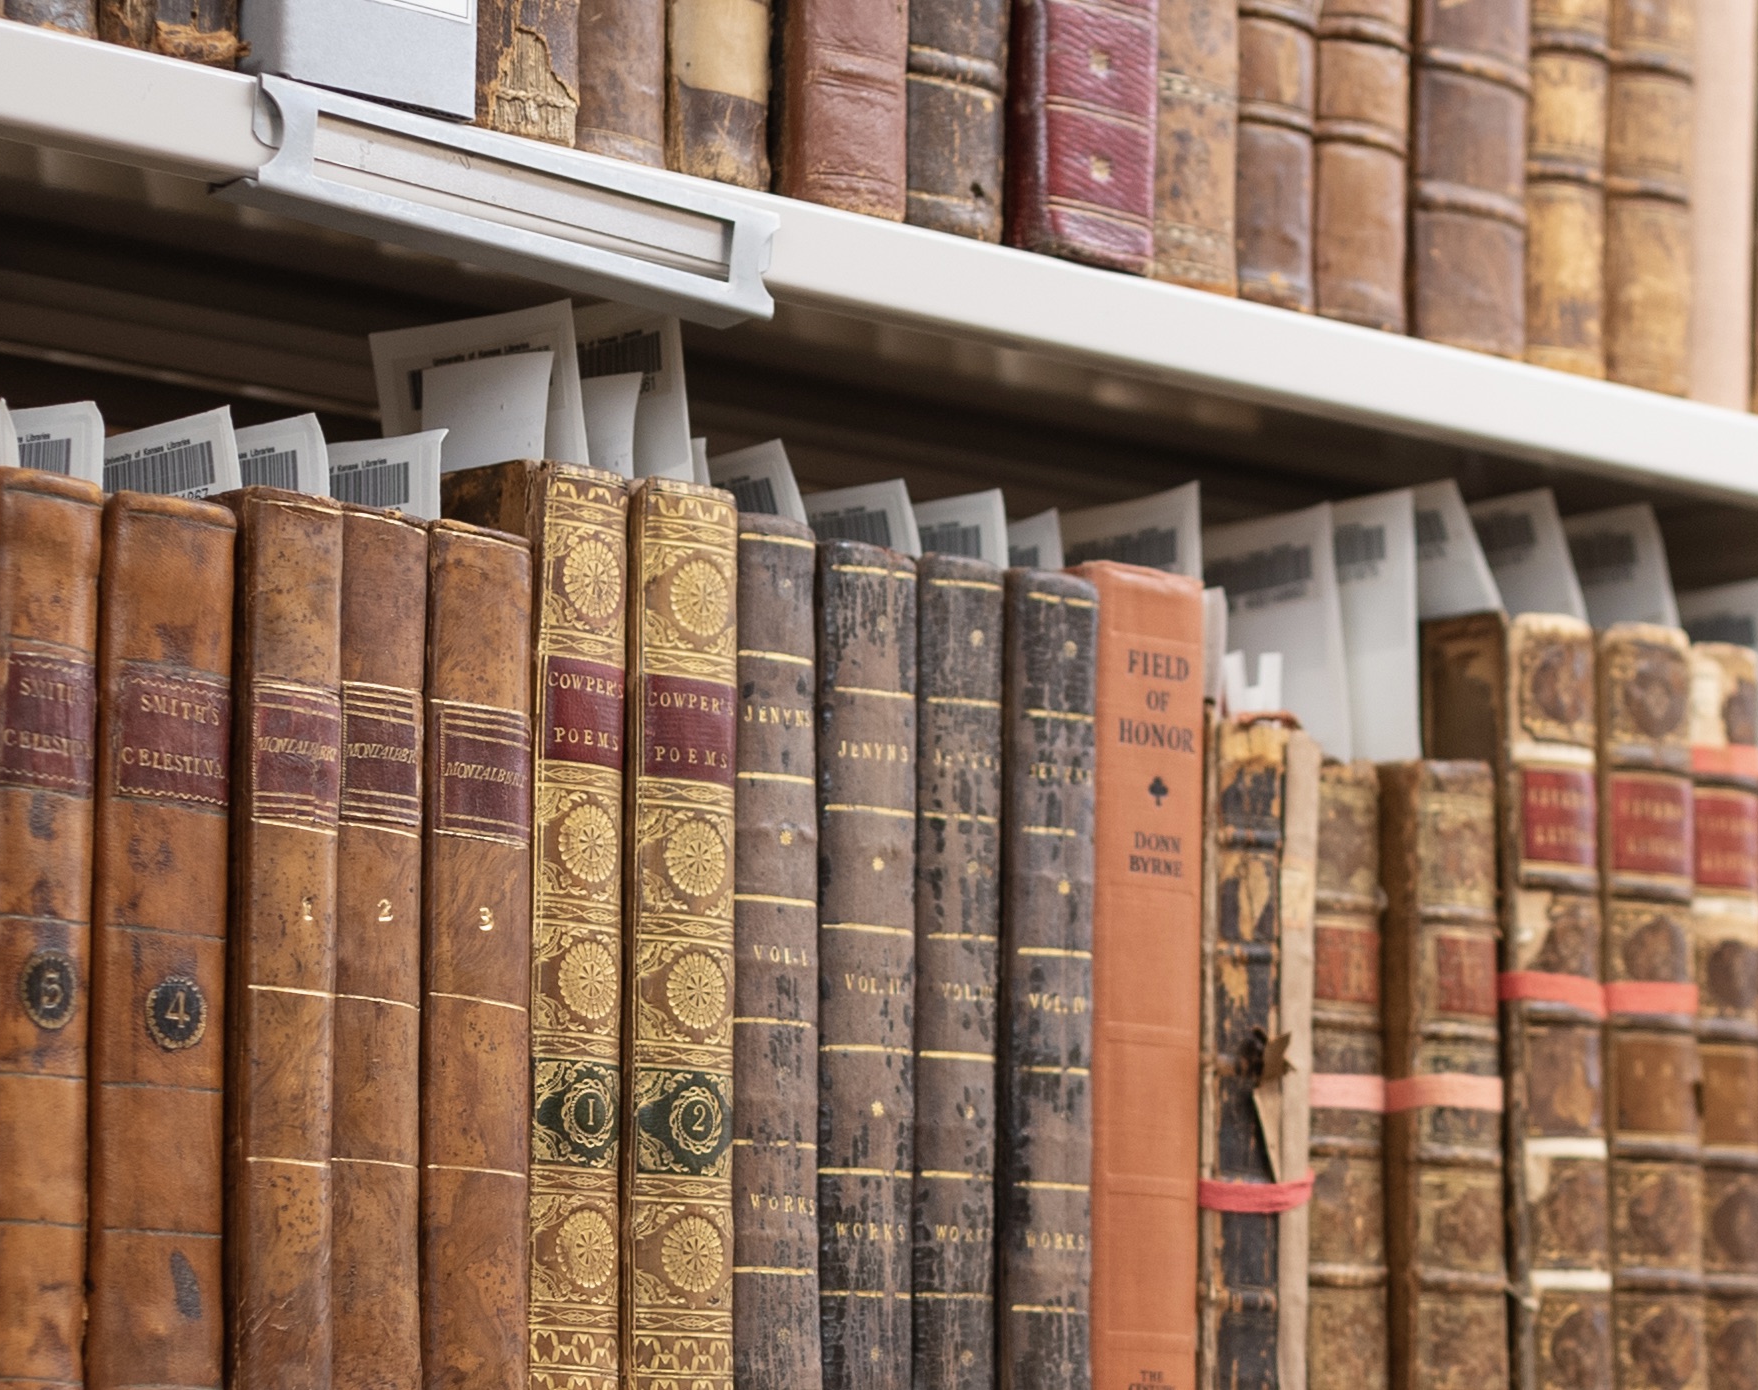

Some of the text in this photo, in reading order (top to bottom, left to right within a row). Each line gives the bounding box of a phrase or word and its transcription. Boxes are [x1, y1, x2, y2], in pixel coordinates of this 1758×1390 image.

[166, 438, 190, 450] Libraries
[1128, 649, 1190, 682] FIELD
[548, 671, 624, 699] COWPER'S
[140, 693, 220, 726] SMITH'S
[648, 691, 734, 717] COWPER'S
[1146, 689, 1170, 713] OF
[744, 704, 812, 728] JENYNS
[553, 727, 619, 751] POEMS
[1119, 717, 1195, 753] HONOR
[121, 747, 226, 779] CELESTINA
[654, 746, 728, 769] POEMS
[838, 740, 909, 763] JENYNS
[1134, 831, 1181, 854] DONN
[1129, 853, 1183, 878] BYRNE
[377, 899, 394, 922] 2
[478, 906, 495, 932] 3
[164, 990, 190, 1028] 4
[692, 1104, 706, 1132] 2
[750, 1193, 816, 1216] WORKS
[835, 1221, 906, 1242] WORKS
[1025, 1230, 1086, 1251] WORKS
[1140, 1369, 1164, 1382] THE
